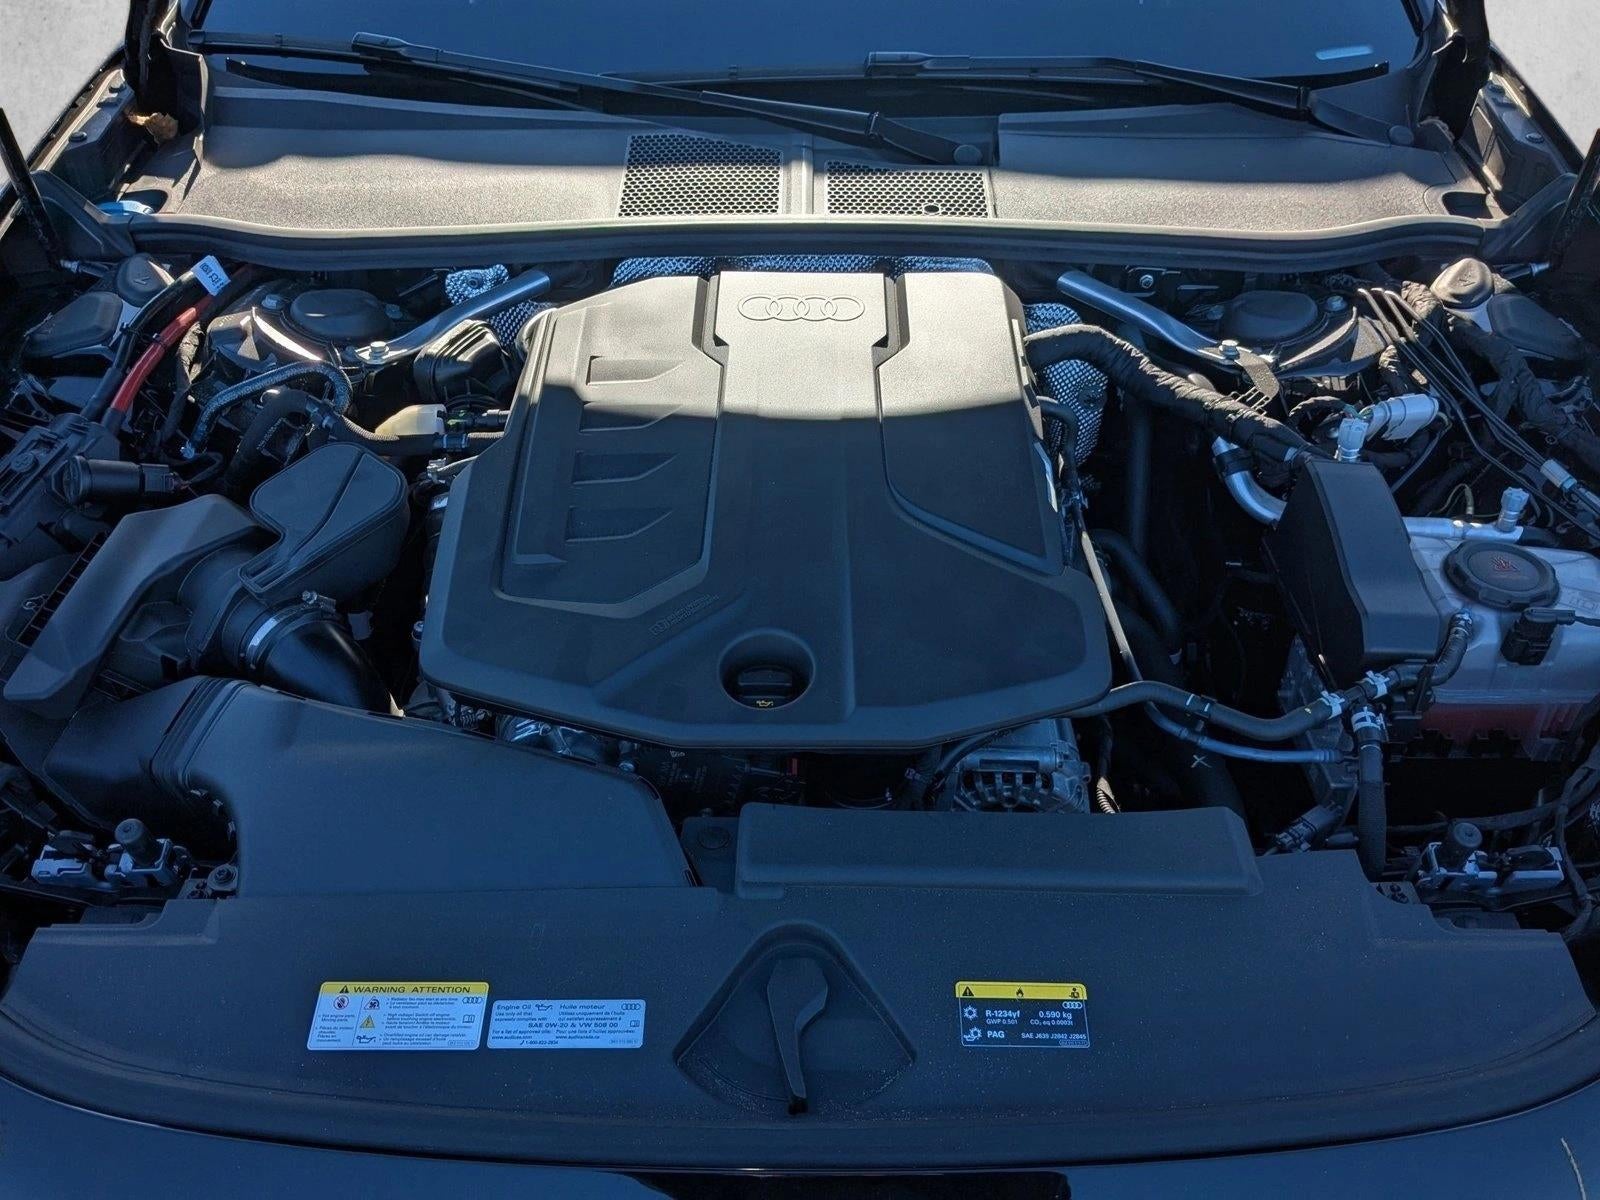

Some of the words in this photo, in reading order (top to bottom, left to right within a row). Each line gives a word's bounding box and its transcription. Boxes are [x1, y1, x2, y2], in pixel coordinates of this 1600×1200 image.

[985, 1009, 1020, 1019] R-1234yf
[1038, 1010, 1061, 1018] 0.590
[1062, 1011, 1072, 1019] kg
[987, 1030, 1005, 1038] PAG
